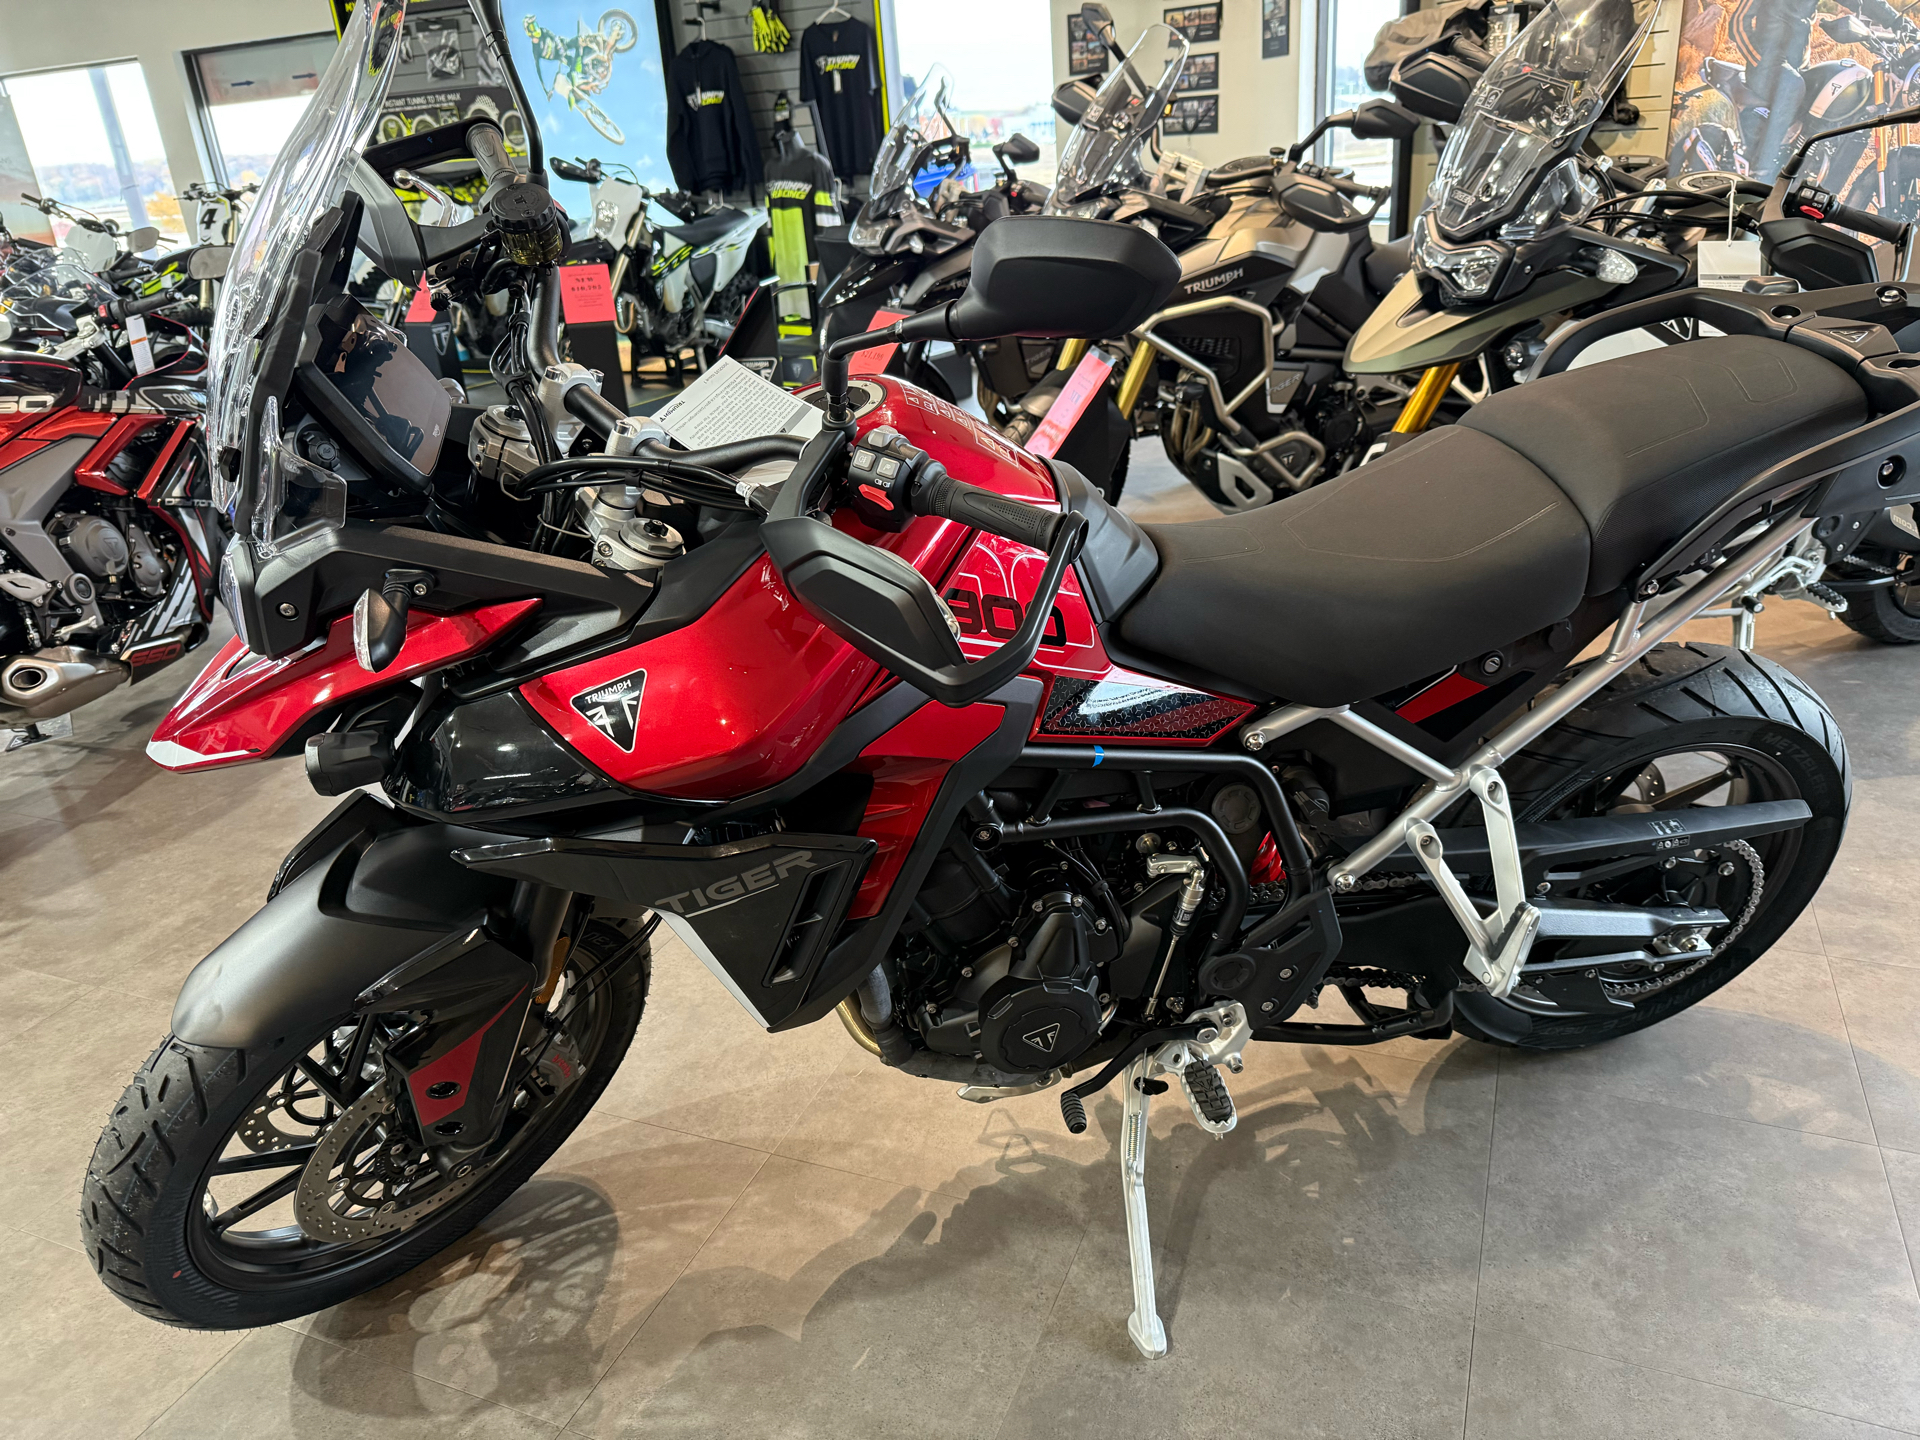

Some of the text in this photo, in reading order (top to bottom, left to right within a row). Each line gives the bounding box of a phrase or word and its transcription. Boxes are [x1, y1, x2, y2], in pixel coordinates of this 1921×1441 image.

[771, 189, 806, 200] RACING
[774, 181, 812, 192] TRIUMPH
[200, 208, 218, 230] 4
[1184, 268, 1244, 294] TRIUMPH
[943, 587, 1067, 648] 900
[585, 679, 631, 704] TRIUMPH
[1760, 731, 1829, 795] METZELER
[655, 850, 817, 913] TIGER
